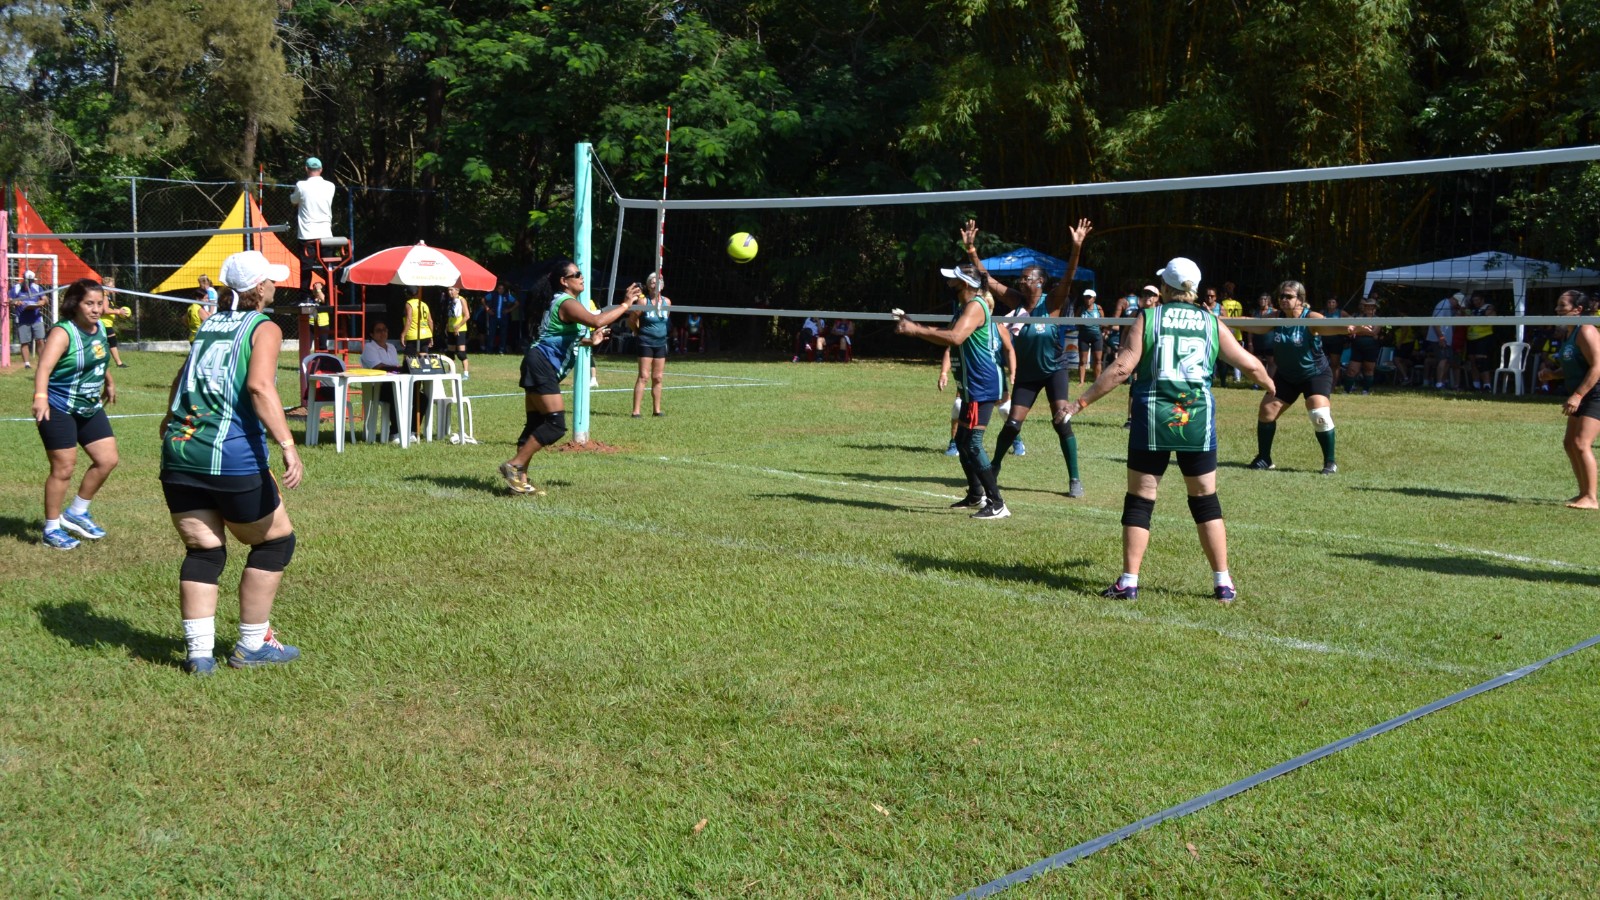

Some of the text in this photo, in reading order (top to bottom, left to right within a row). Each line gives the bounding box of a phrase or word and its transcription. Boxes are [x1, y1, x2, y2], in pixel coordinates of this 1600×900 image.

[1165, 308, 1203, 320] ATIBA
[200, 319, 243, 333] BAURU
[1162, 317, 1206, 331] BAURU
[410, 358, 441, 369] 4 2
[1157, 334, 1206, 383] 12
[186, 339, 232, 394] 14
